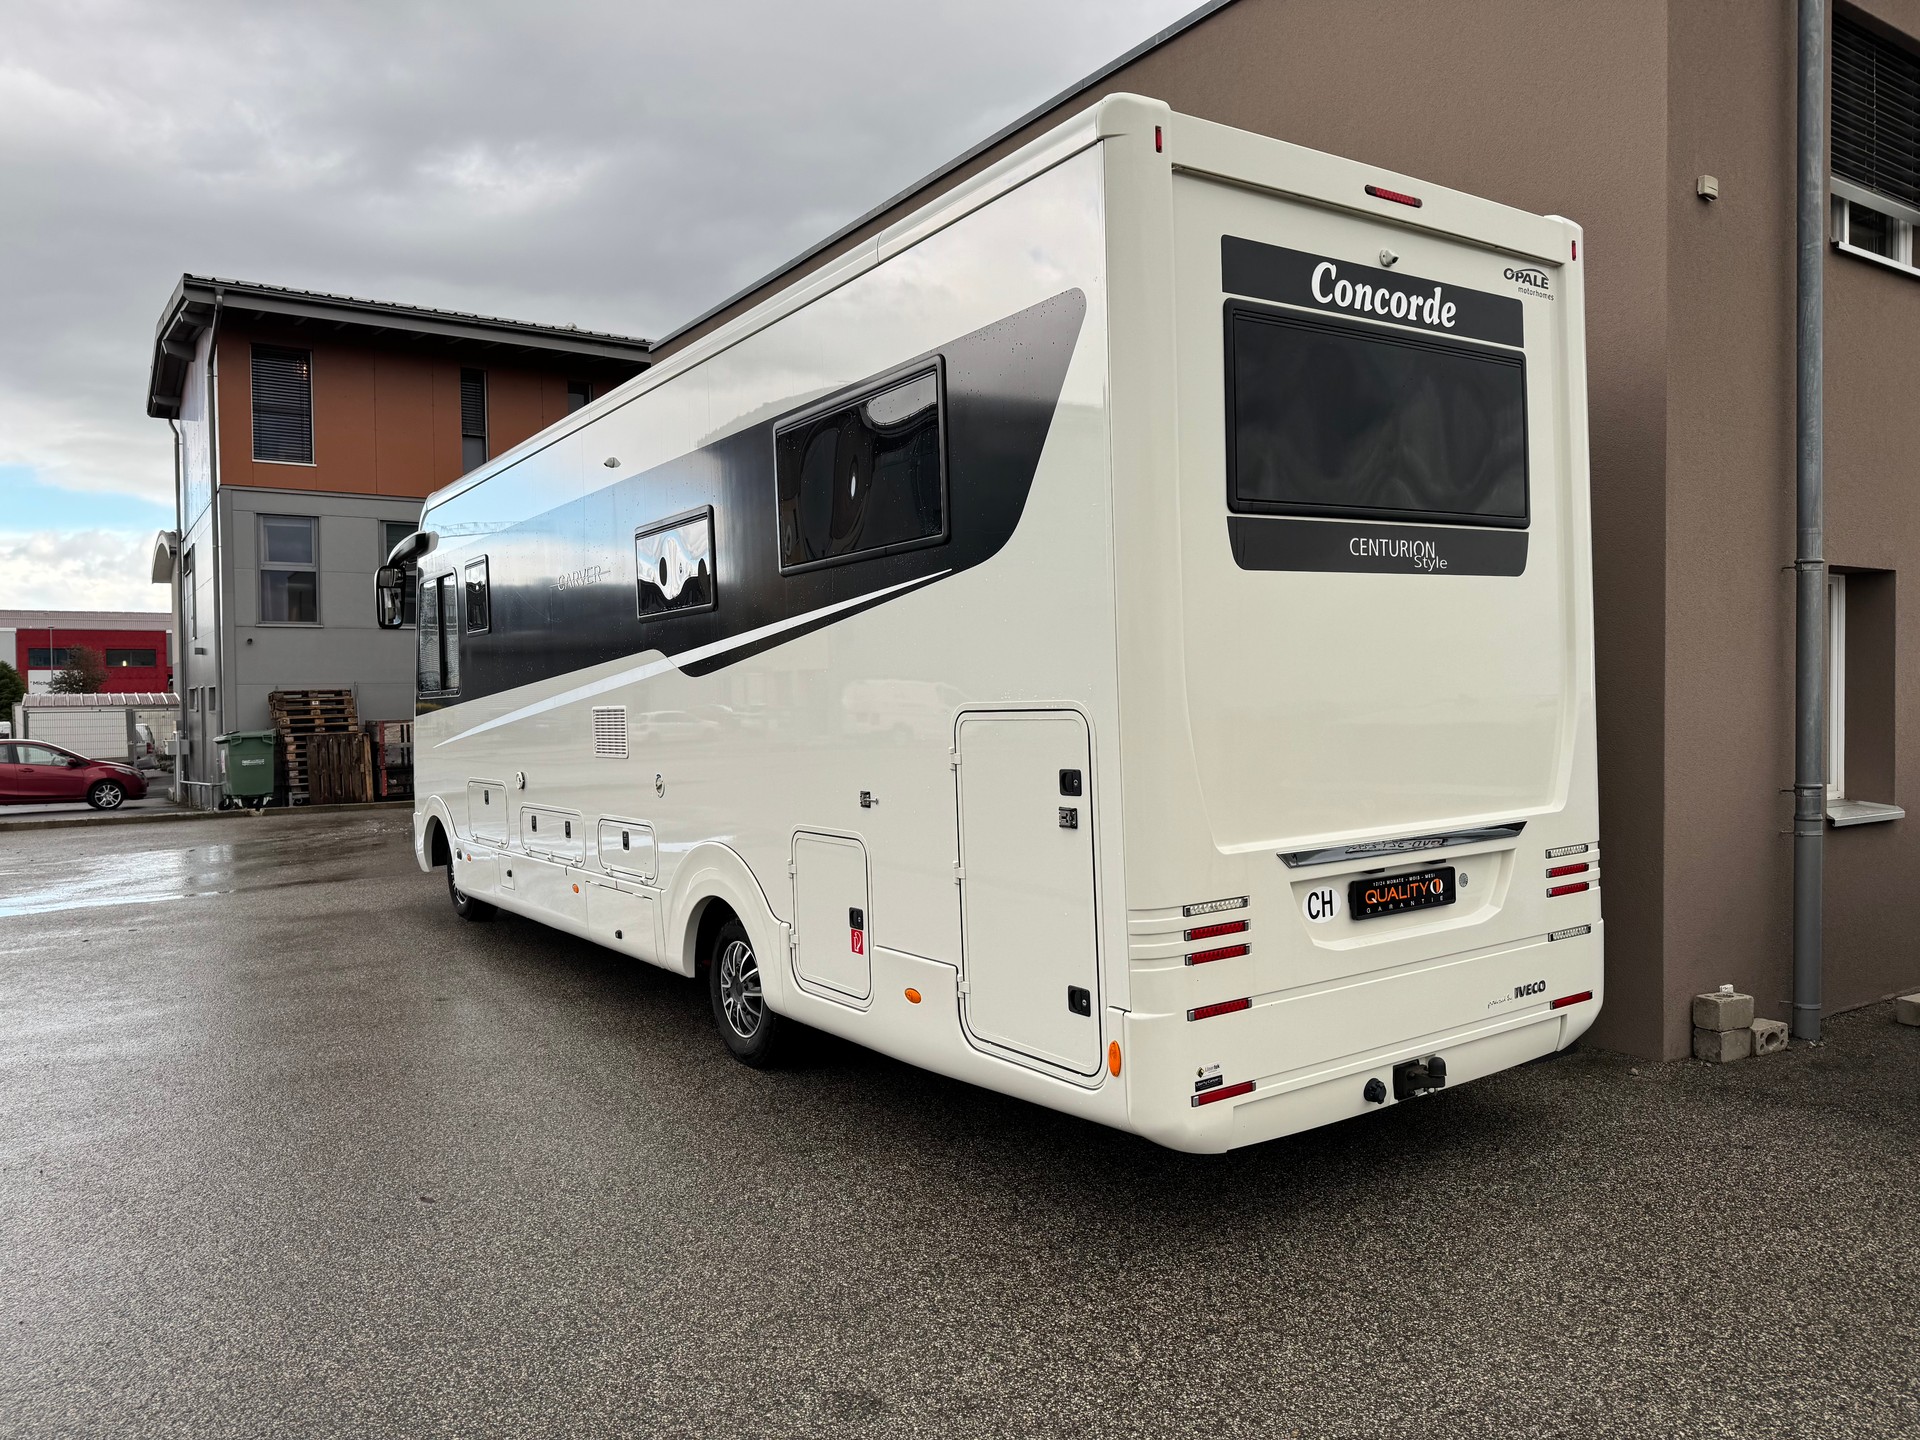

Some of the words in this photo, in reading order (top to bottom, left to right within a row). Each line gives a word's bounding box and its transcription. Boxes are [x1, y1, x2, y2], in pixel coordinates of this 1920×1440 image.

[1503, 267, 1549, 290] OPALE
[1311, 261, 1457, 328] Concorde
[1517, 286, 1555, 301] motorhomes
[1349, 537, 1436, 559] CENTURION
[1414, 555, 1448, 572] Style
[557, 565, 602, 591] CARVER
[1308, 889, 1334, 920] CH
[1365, 881, 1429, 905] QUALITY
[1514, 979, 1546, 999] IVECO
